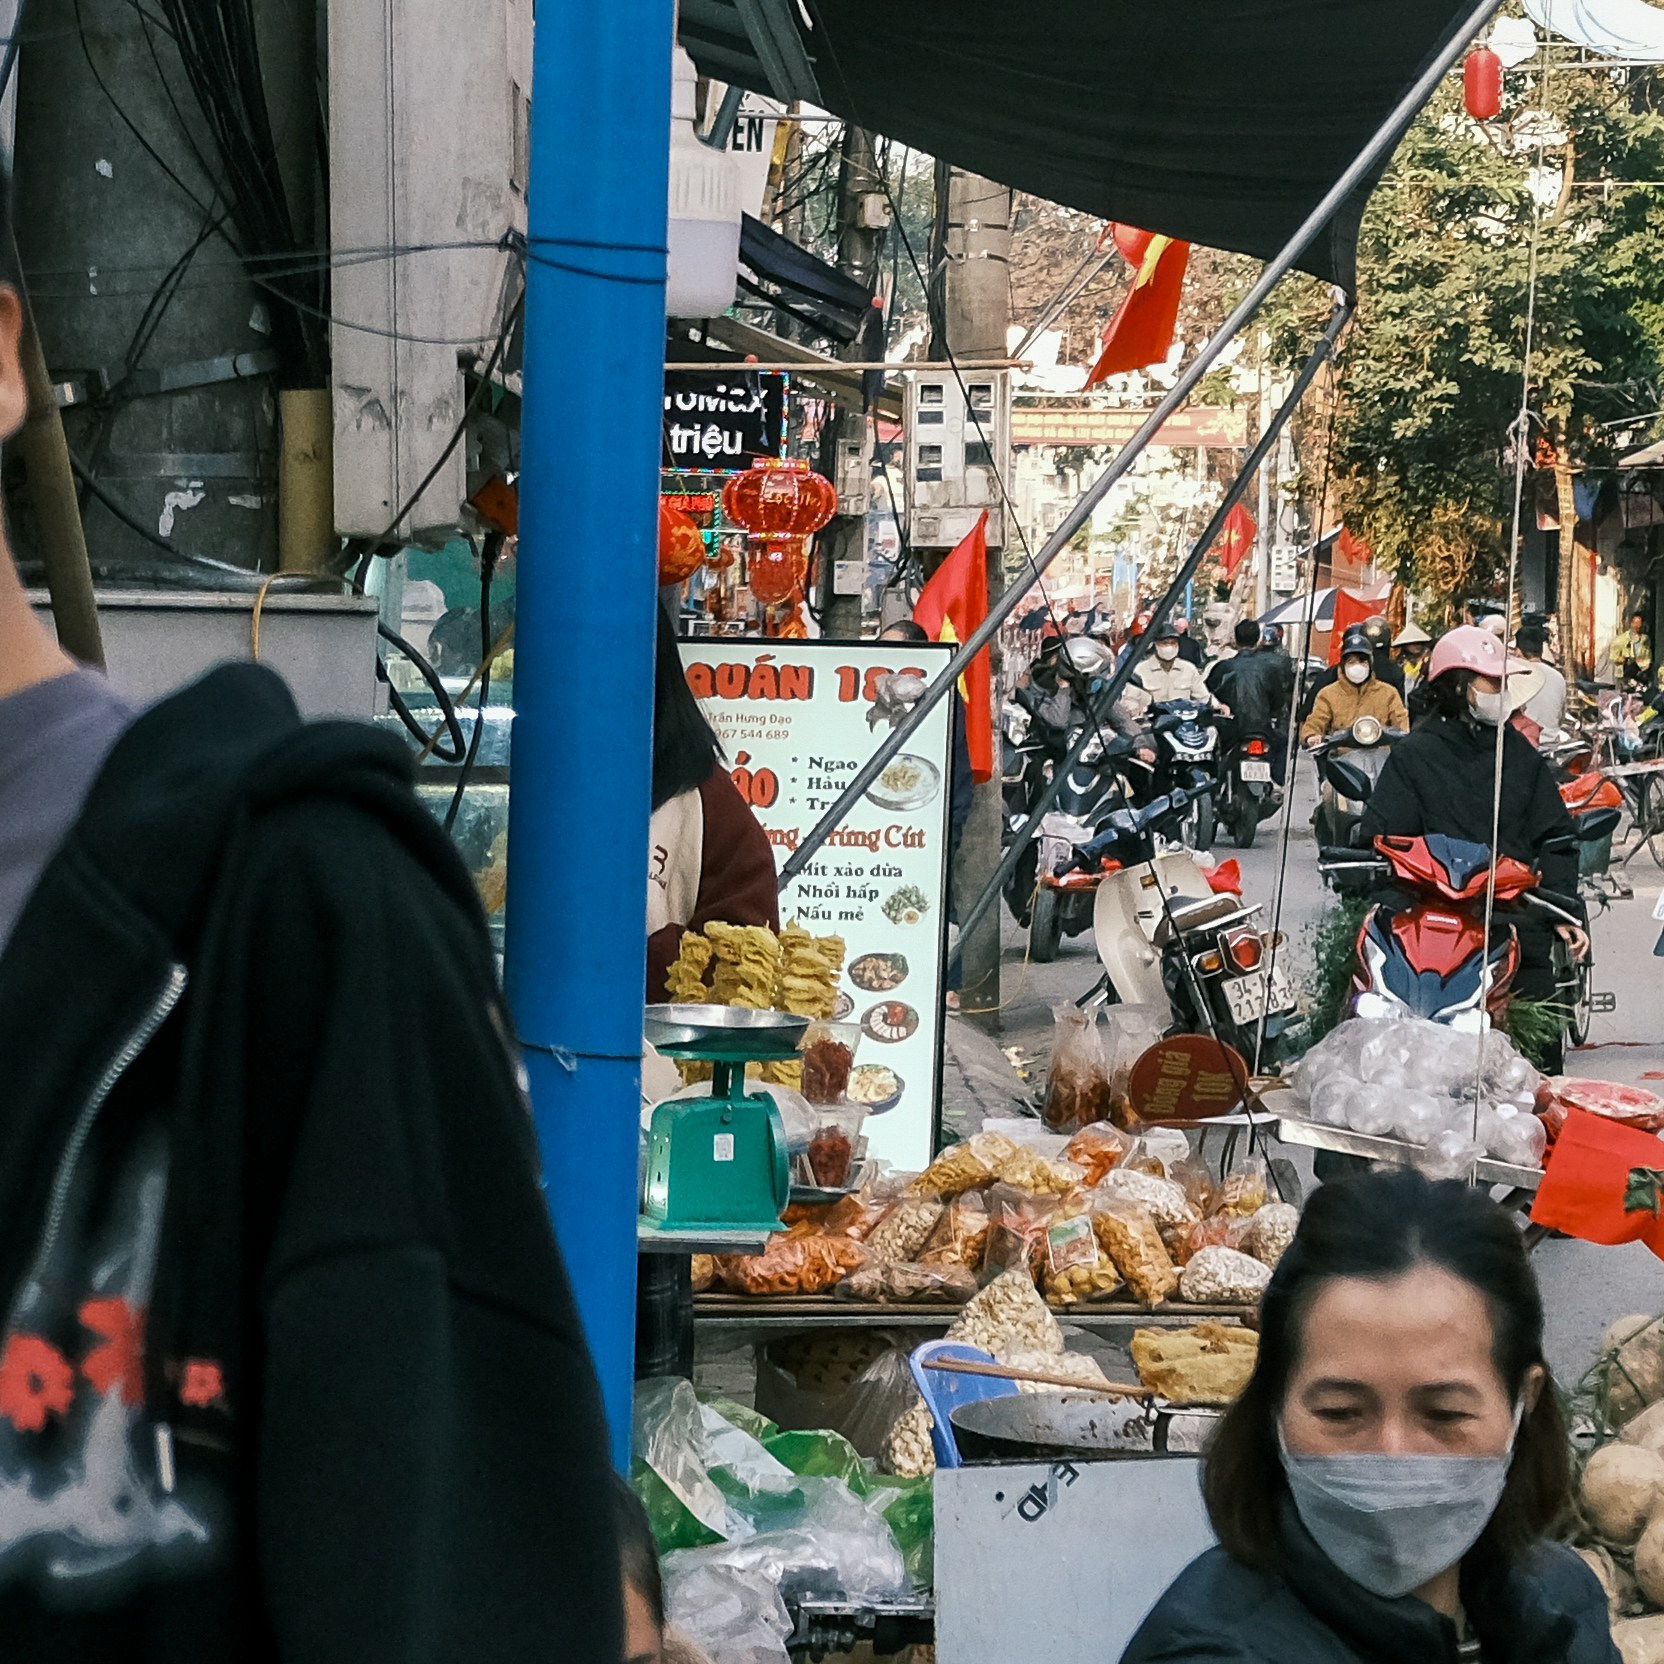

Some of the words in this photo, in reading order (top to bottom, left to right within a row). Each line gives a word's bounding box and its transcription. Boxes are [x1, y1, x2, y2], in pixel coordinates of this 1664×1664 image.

[670, 423, 744, 459] triệu
[686, 654, 814, 701] QUÁN
[835, 665, 927, 702] 18
[736, 713, 766, 726] Hưng
[769, 714, 792, 725] Đạo
[740, 729, 763, 739] 544
[765, 729, 789, 740] 689
[808, 757, 858, 773] Ngao
[822, 824, 881, 853] rứng
[846, 882, 879, 902] hấp
[797, 904, 832, 921] Nấu
